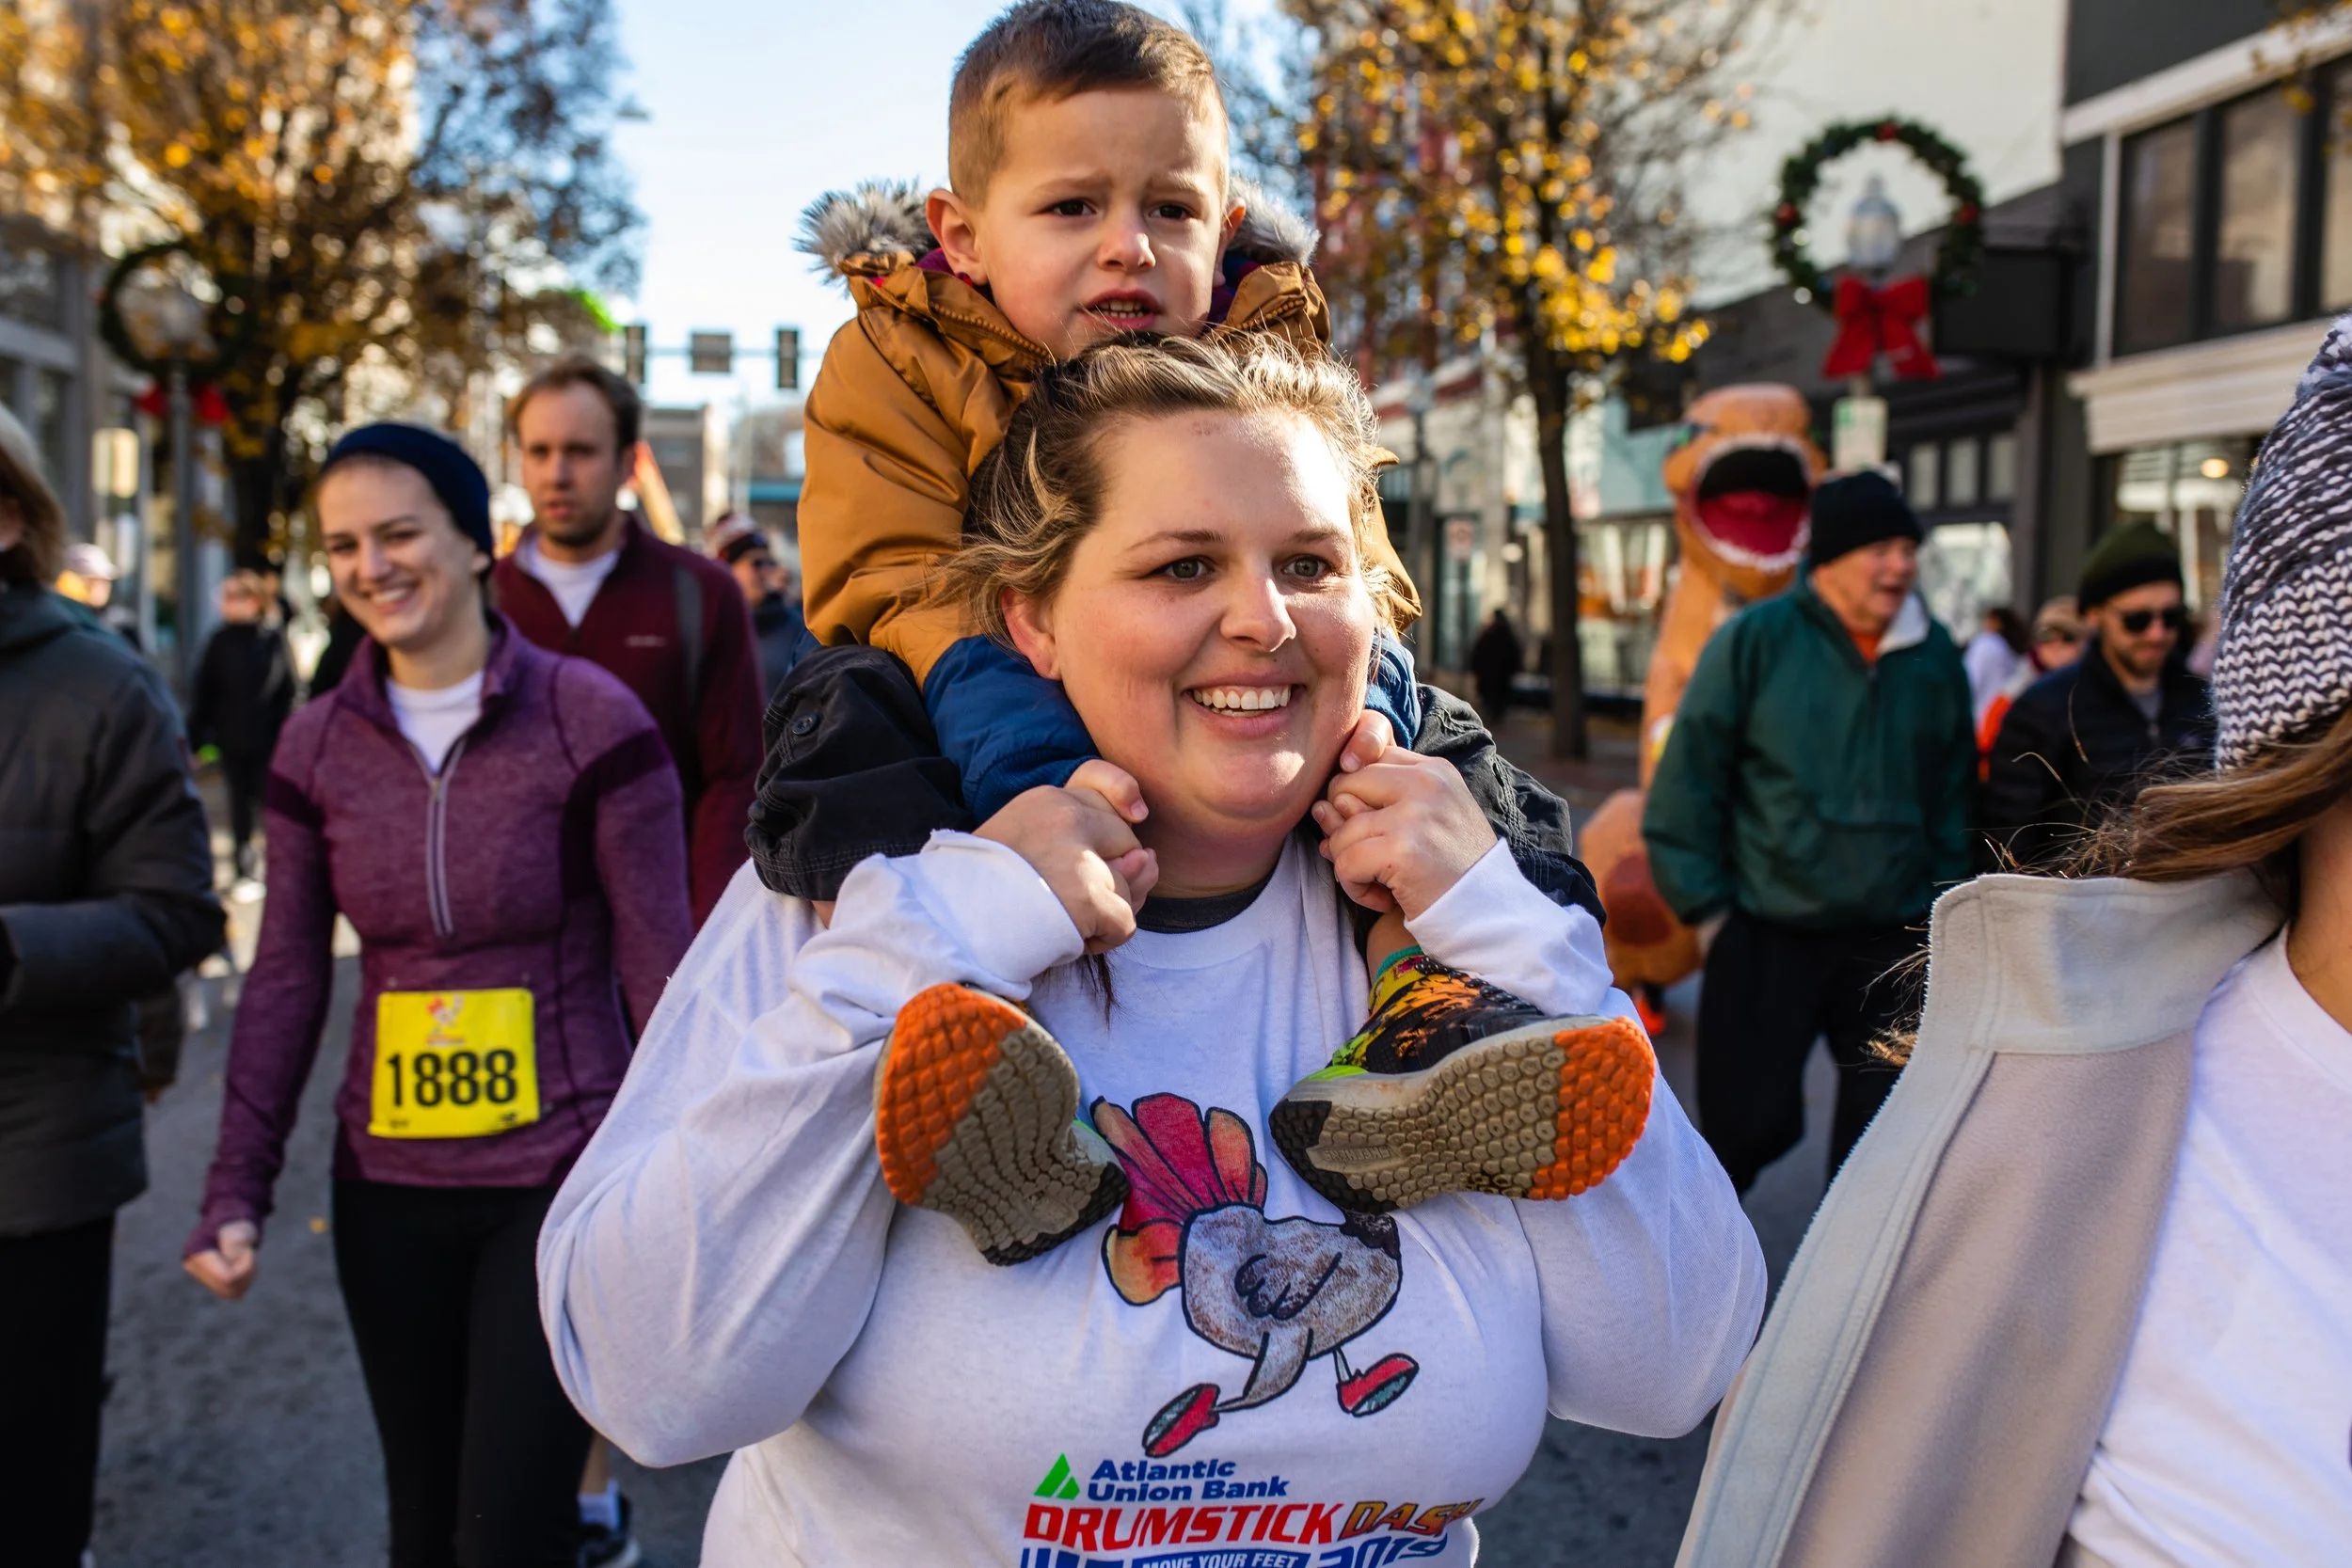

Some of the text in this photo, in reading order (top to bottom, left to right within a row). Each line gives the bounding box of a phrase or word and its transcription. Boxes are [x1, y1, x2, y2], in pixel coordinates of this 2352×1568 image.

[387, 1049, 517, 1108] 1888
[1090, 1459, 1236, 1481] Atlantic
[1088, 1476, 1290, 1502] Union Bank
[1024, 1503, 1343, 1552] DRUMSTICK
[1198, 1553, 1248, 1568] YOUR
[1250, 1552, 1299, 1568] FEET
